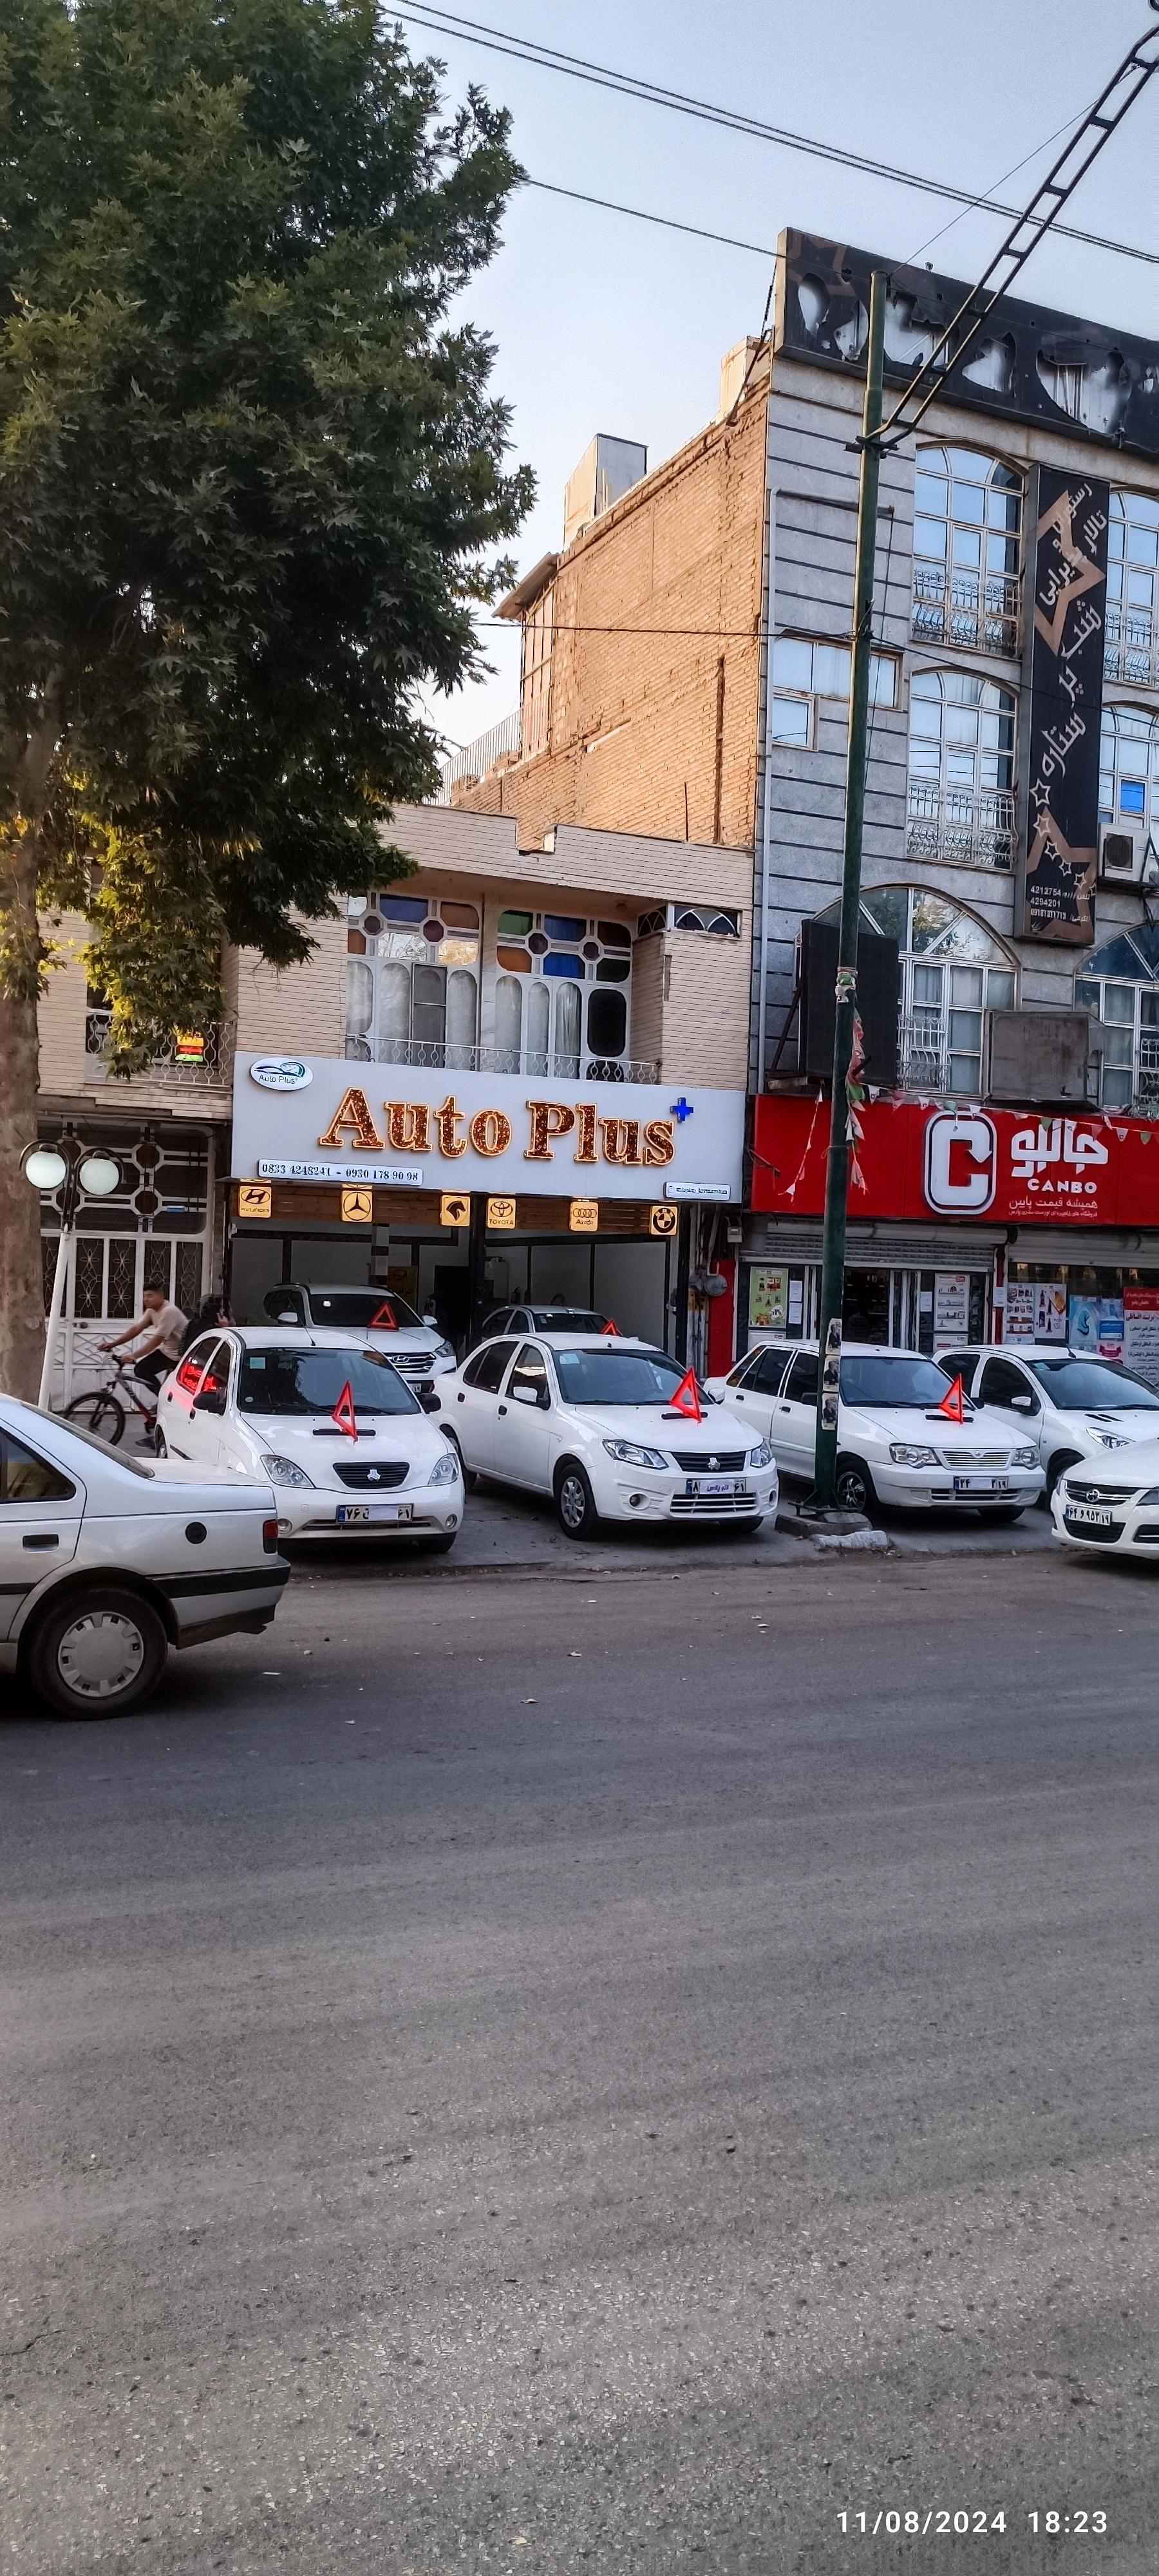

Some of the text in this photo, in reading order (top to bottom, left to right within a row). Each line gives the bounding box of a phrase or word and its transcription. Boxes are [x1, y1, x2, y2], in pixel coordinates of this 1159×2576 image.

[1084, 509, 1107, 556] تالار
[1041, 600, 1102, 780] شب پر ستاره
[1031, 885, 1062, 897] 4212754
[1030, 897, 1061, 909] 4294201
[258, 1074, 277, 1084] Auto
[318, 1086, 677, 1166] Auto Plus
[262, 1163, 287, 1174] 0833
[346, 1168, 370, 1179] 0930
[372, 1169, 390, 1180] 178
[391, 1170, 404, 1181] 90
[1027, 1178, 1098, 1194] CANBO
[1035, 1197, 1064, 1209] قیمت
[1066, 1198, 1098, 1210] همیشه
